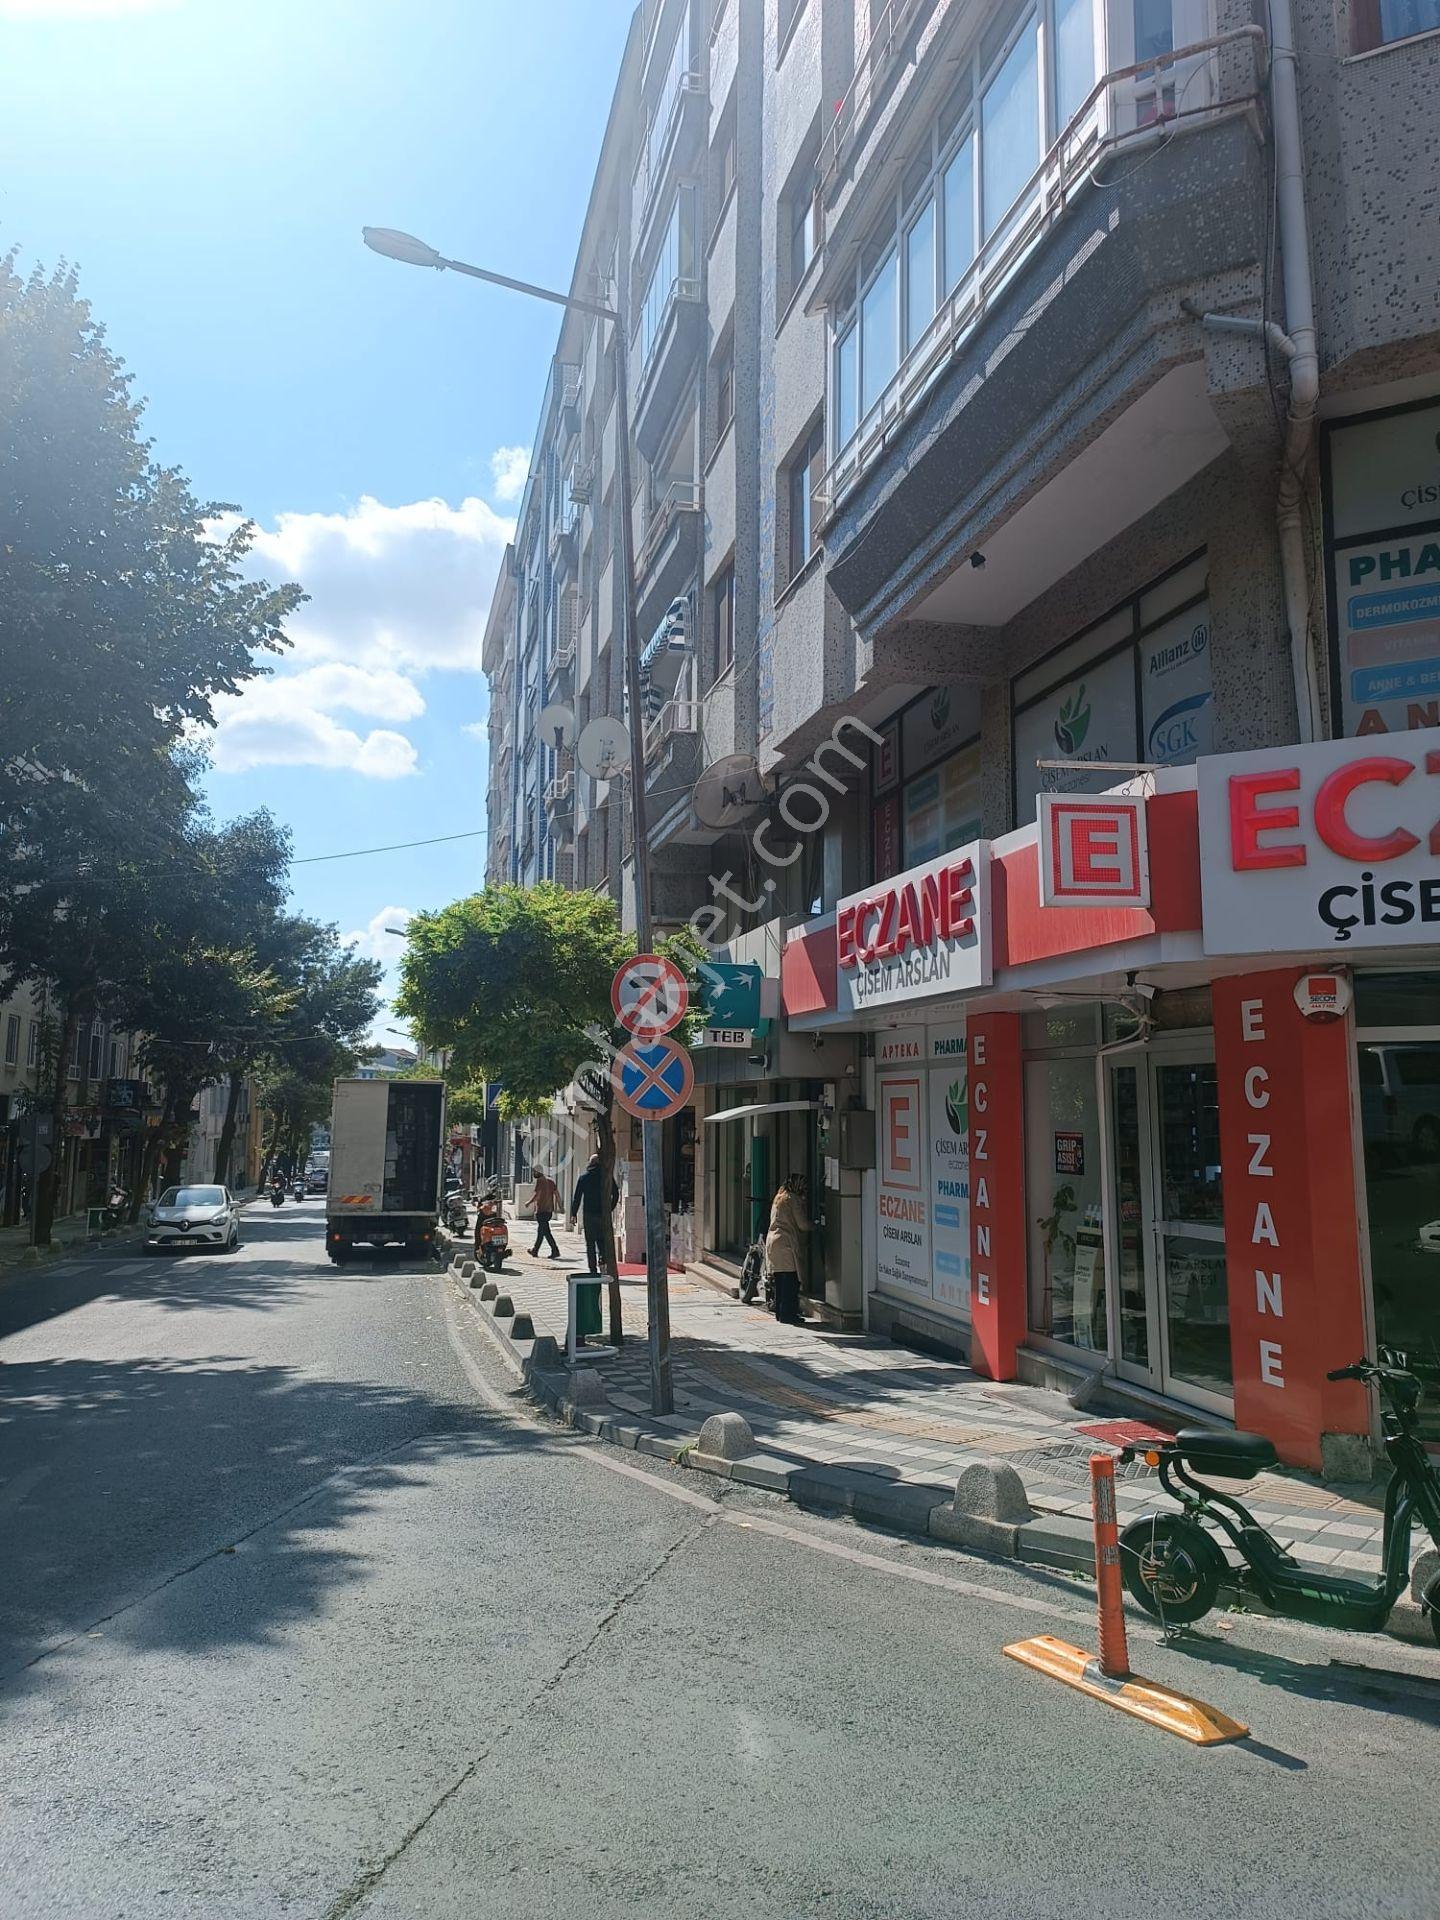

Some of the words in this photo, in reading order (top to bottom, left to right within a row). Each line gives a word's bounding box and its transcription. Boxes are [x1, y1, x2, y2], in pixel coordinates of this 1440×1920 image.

[1401, 485, 1440, 510] ÇİS
[1150, 640, 1189, 674] Allianz
[1157, 716, 1199, 759] SGK
[1229, 748, 1440, 871] EC
[838, 857, 974, 969] ECZANE
[895, 951, 950, 990] ARSLAN
[709, 1030, 745, 1043] TEB
[882, 1042, 919, 1059] APTEKA
[936, 1138, 957, 1157] ÇİSEM
[972, 1036, 992, 1305] ECZANE
[880, 1195, 926, 1224] ECZANE
[1240, 1000, 1288, 1388] ECZANE
[883, 1224, 899, 1241] ÇİSEM
[900, 1229, 922, 1246] ARSLAN
